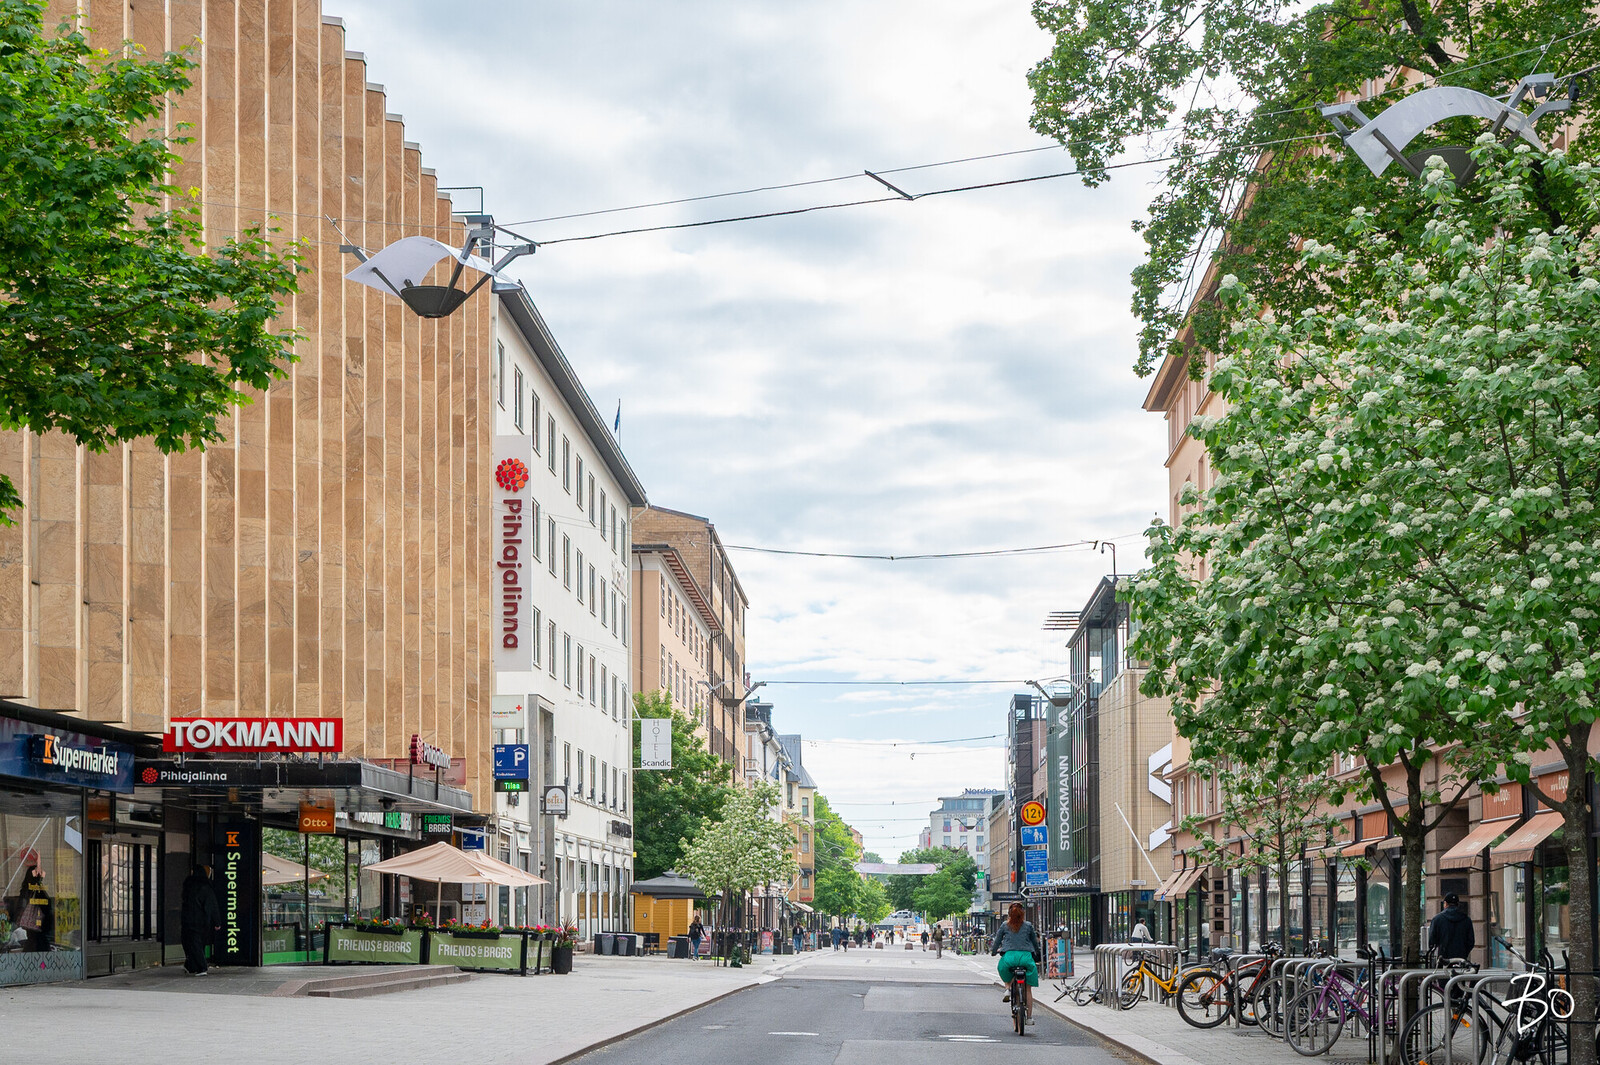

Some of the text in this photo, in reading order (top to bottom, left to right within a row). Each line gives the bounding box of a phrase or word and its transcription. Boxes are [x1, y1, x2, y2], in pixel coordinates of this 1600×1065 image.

[497, 499, 522, 649] Pihlajalinna
[171, 719, 335, 749] TOKMANNI
[652, 720, 660, 759] HOTEL
[43, 734, 118, 776] K Supermarket
[514, 752, 525, 766] P
[160, 771, 228, 784] Pihlajalinna
[1059, 756, 1070, 850] STOCKMANN
[424, 815, 450, 824] FRIENDS
[428, 824, 451, 832] BRGRS
[225, 832, 240, 953] K Supermarket
[338, 938, 376, 952] FRIENDS
[383, 941, 412, 953] BRGRS
[438, 944, 476, 957] FRIENDS
[484, 946, 512, 958] BRGRS
